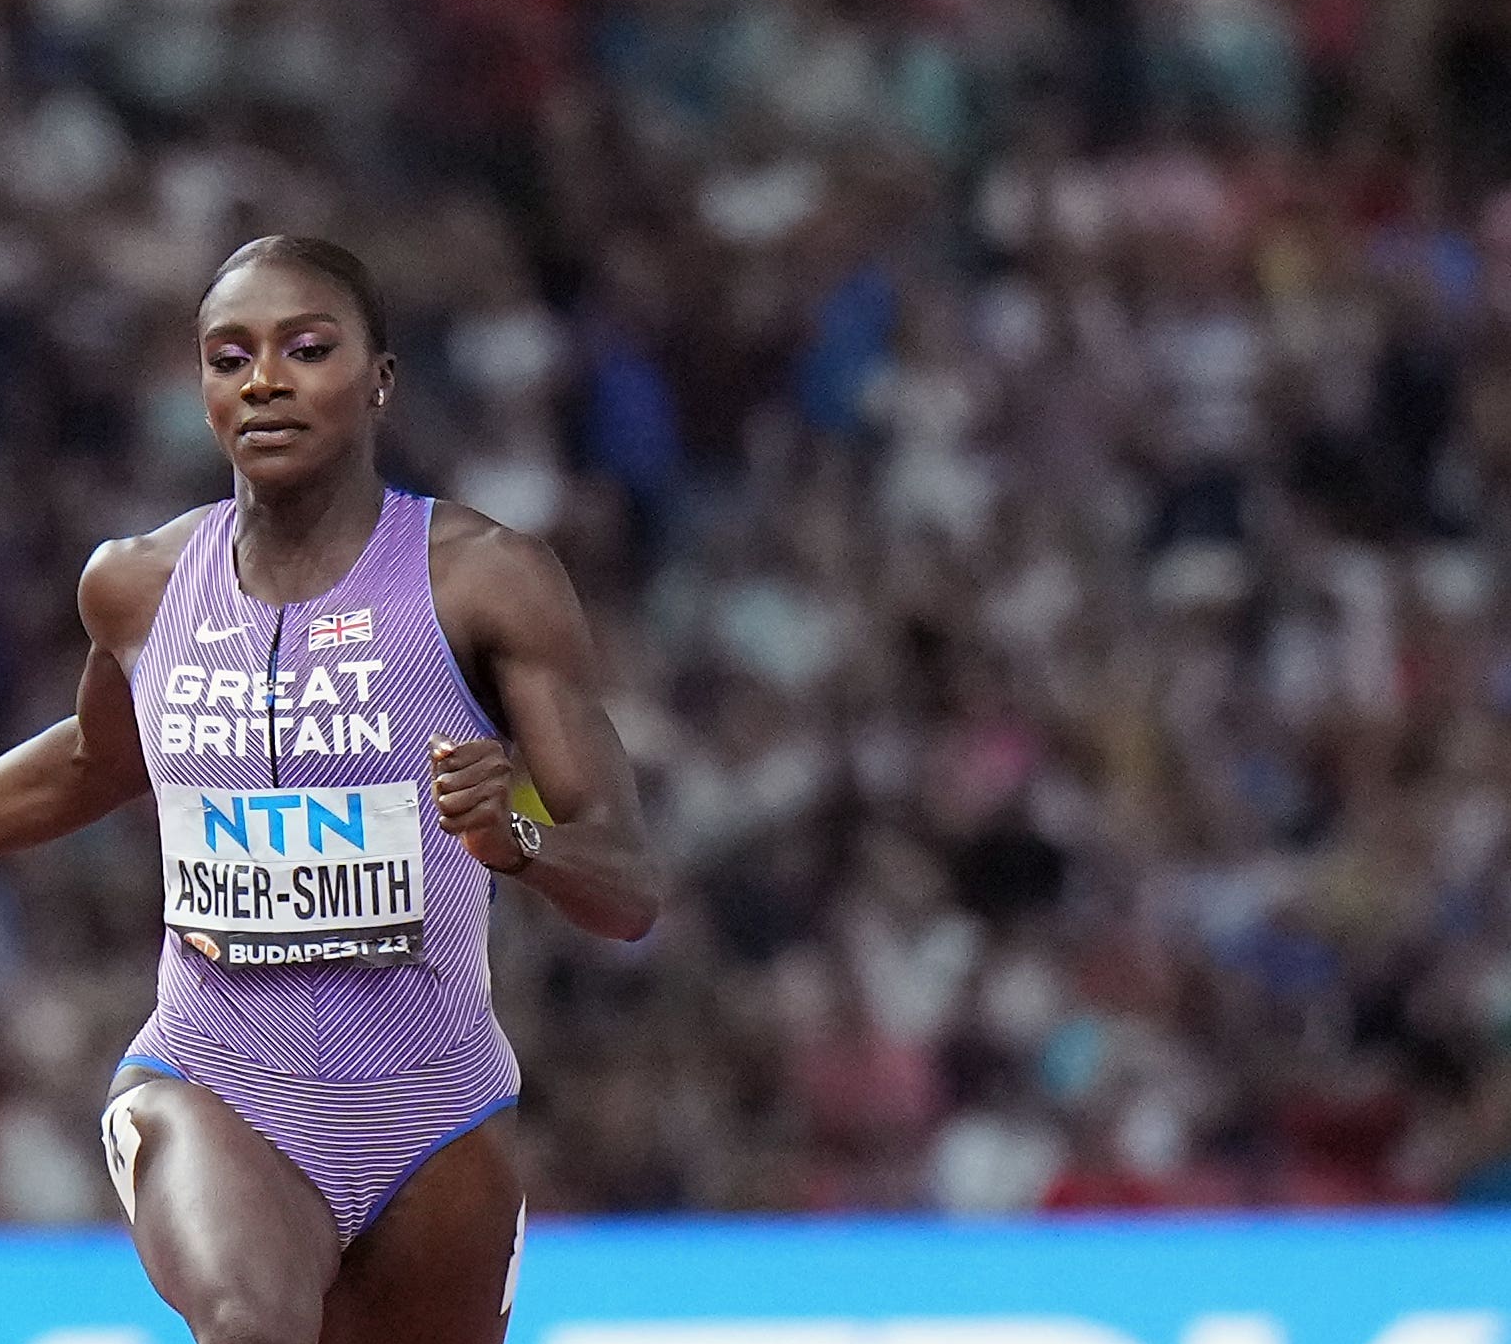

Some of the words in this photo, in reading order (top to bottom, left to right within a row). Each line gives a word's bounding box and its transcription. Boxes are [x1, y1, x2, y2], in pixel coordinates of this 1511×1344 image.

[166, 659, 383, 712] GREAT
[160, 711, 392, 758] BRITAIN
[200, 792, 366, 857] NTN
[174, 858, 412, 921] ASHER-SMITH
[228, 939, 370, 965] BUDAPEST
[377, 933, 410, 954] 23
